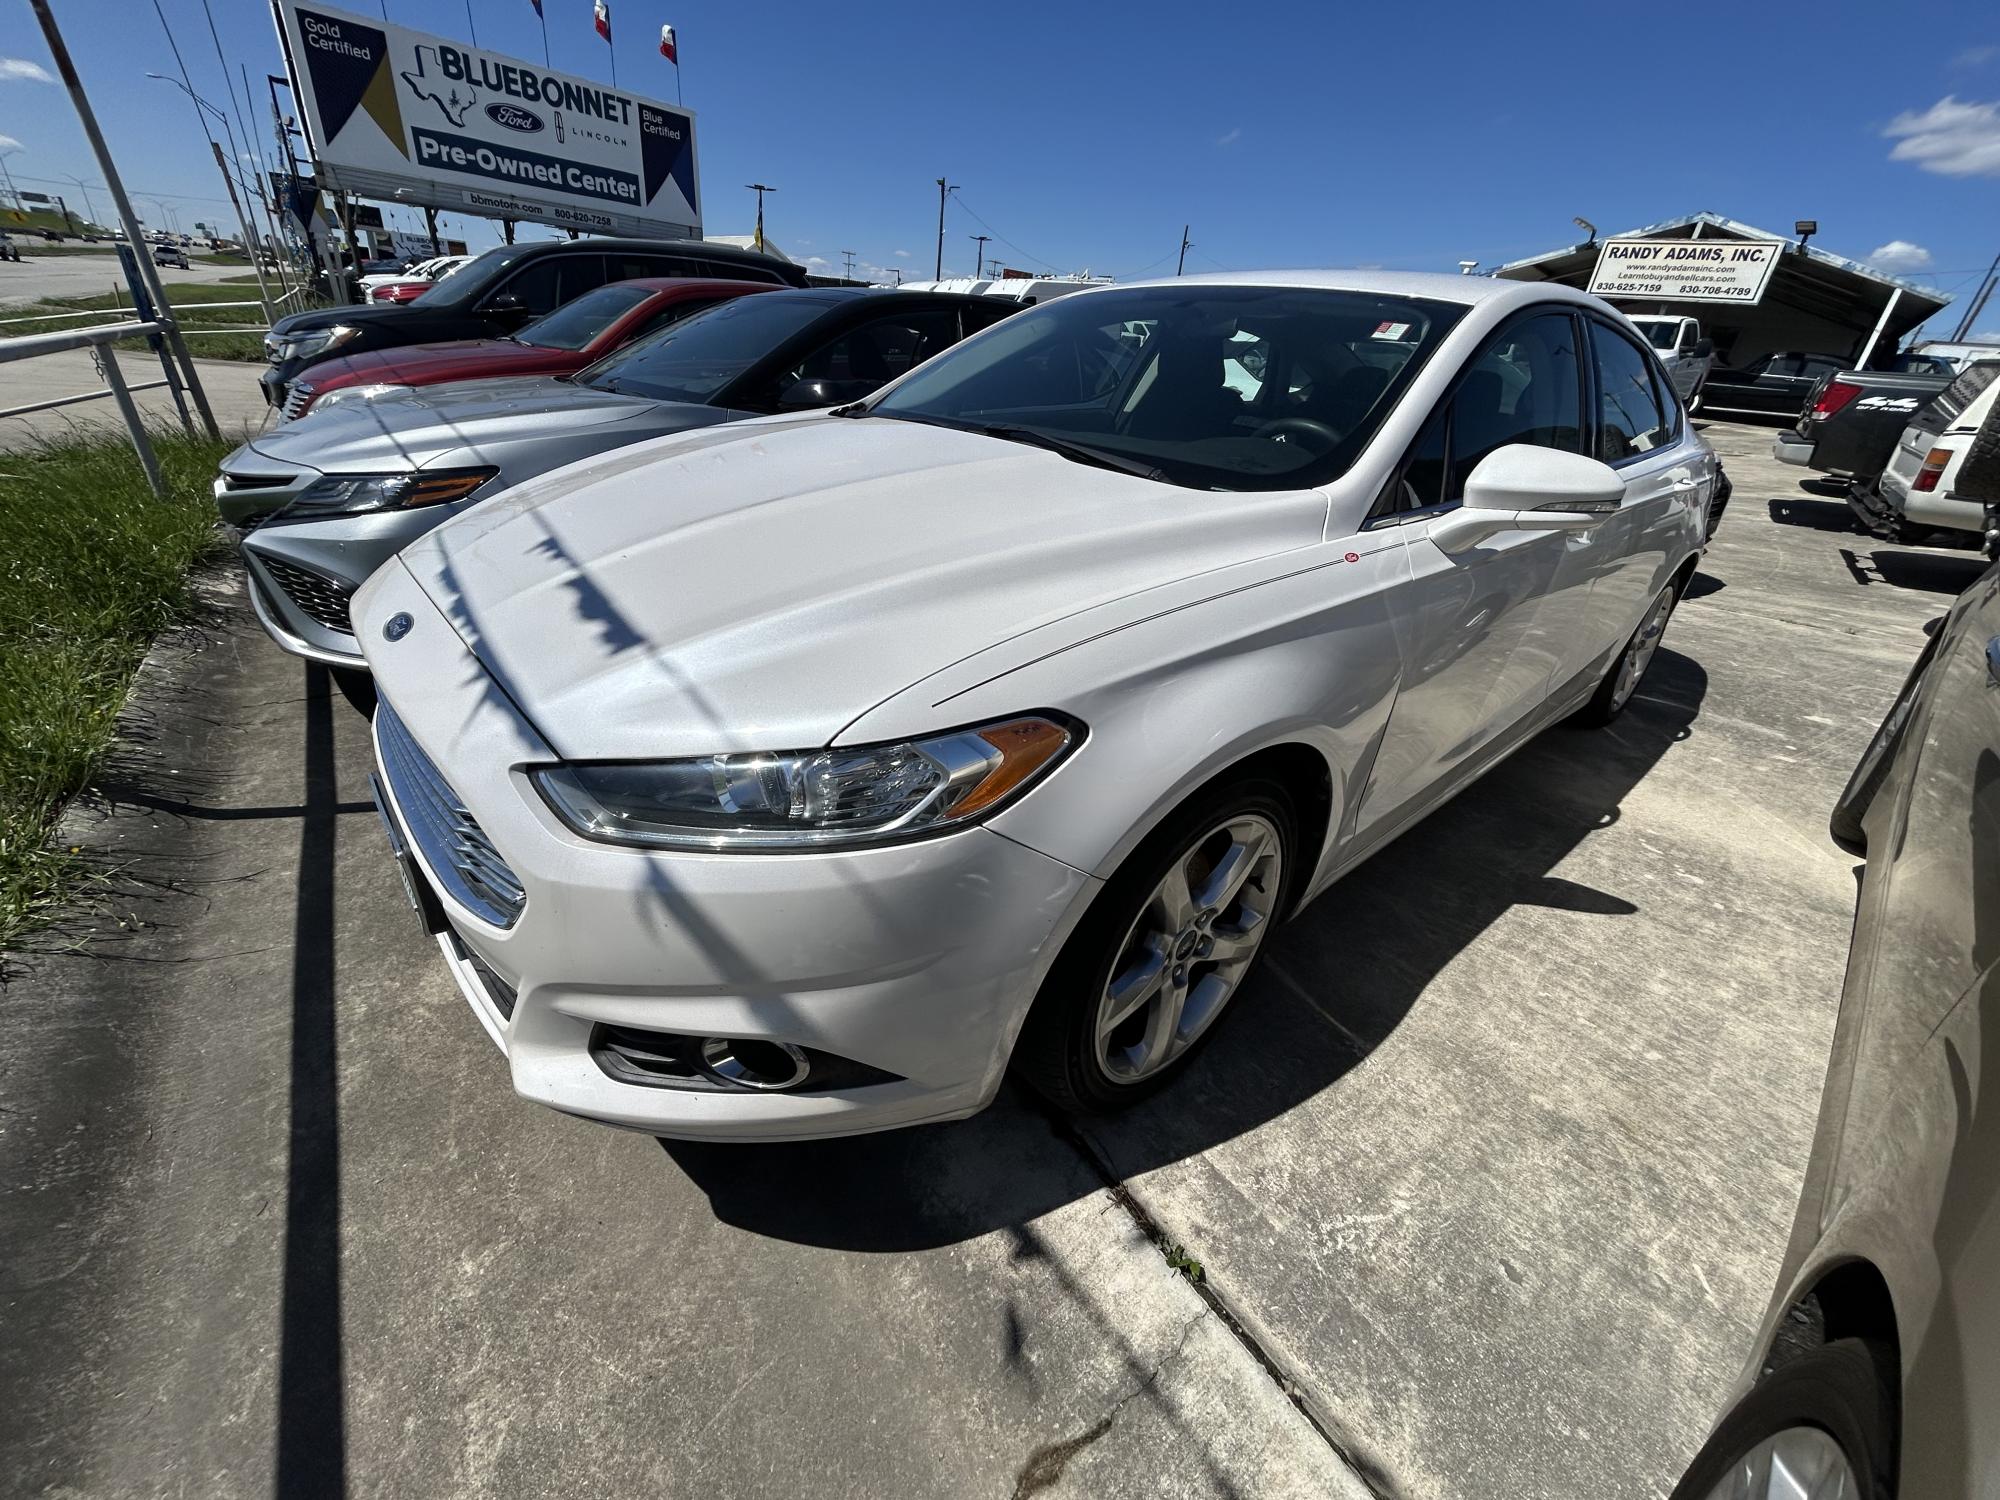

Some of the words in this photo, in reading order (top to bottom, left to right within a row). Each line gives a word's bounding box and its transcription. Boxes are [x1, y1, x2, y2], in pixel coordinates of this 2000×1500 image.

[304, 17, 341, 39] Gold
[308, 33, 371, 60] Certified
[438, 45, 632, 126] BLUEBONNET
[496, 106, 533, 130] Ford
[642, 109, 663, 125] Blue
[571, 127, 628, 147] LINCOLN
[643, 121, 681, 140] Certified
[418, 135, 563, 185] Pre-Owned
[566, 168, 637, 199] Center
[470, 193, 543, 215] bbmotors.com
[1608, 246, 1663, 260] RANDY
[1664, 247, 1726, 264] ADAMS,
[1730, 248, 1766, 262] INC.
[1617, 271, 1736, 283] Learntobuyandsellcars.com
[1626, 263, 1736, 273] www.randyadamsinc.com
[1596, 282, 1662, 292] 830-625-7159
[1679, 285, 1752, 296] 830-708-4789
